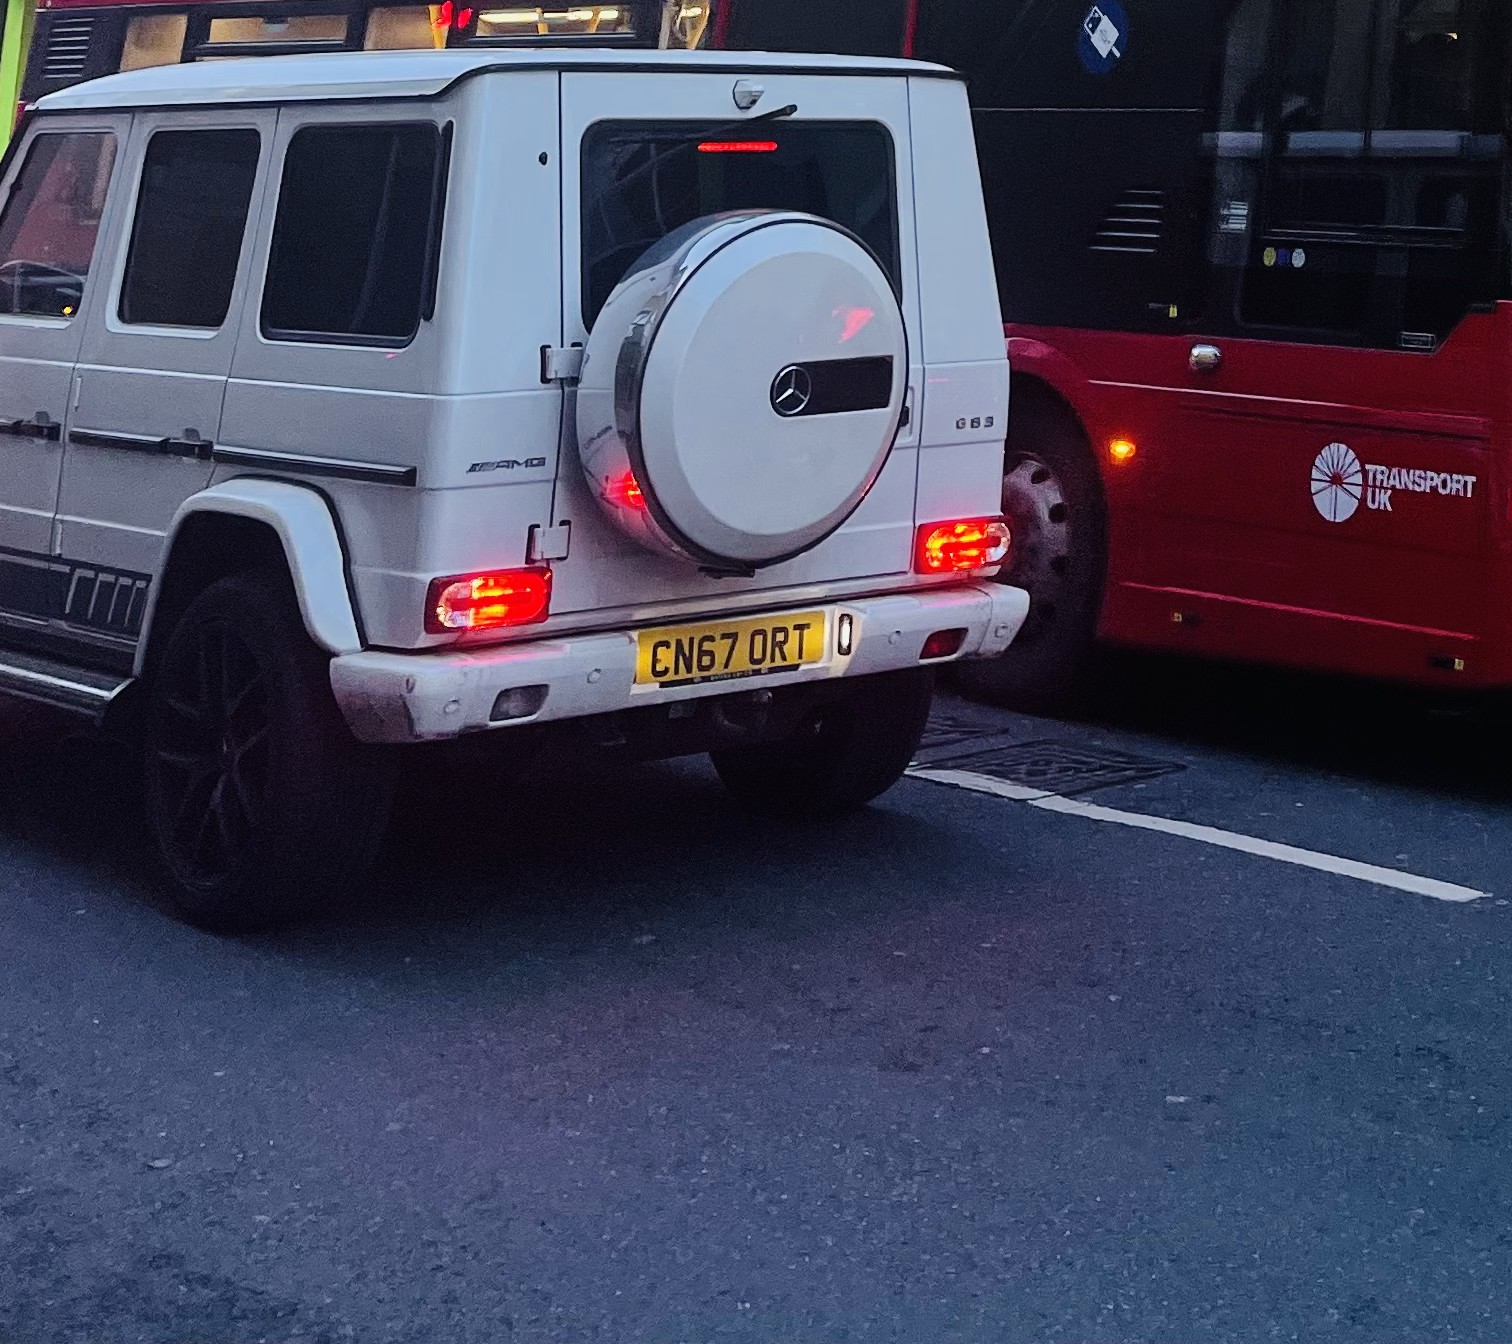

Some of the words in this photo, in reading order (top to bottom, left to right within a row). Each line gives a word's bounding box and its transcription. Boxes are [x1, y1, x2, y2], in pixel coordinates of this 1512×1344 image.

[1365, 463, 1477, 498] TRANSPORT
[1367, 487, 1393, 512] UK
[651, 631, 739, 679] CN67
[748, 622, 811, 667] ORT
